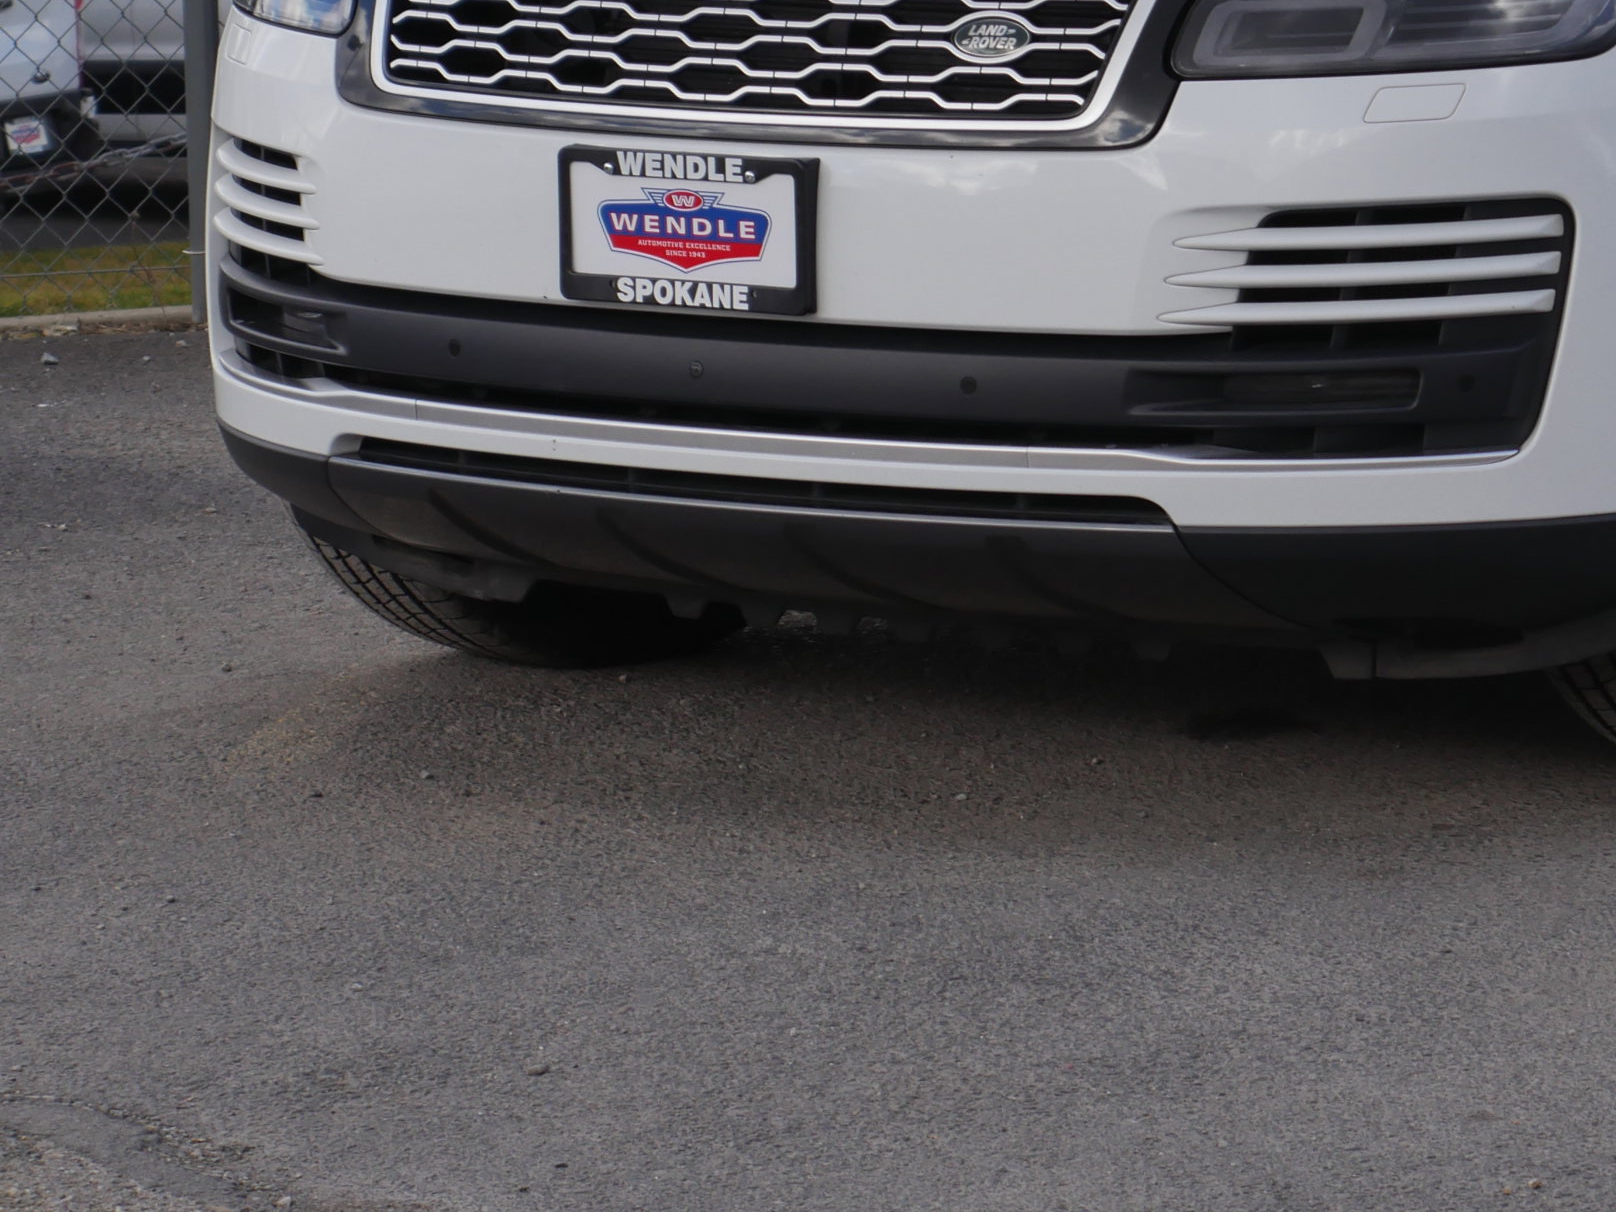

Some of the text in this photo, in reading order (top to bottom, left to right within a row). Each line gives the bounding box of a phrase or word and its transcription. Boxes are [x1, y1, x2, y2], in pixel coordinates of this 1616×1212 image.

[968, 24, 1008, 36] LAND
[968, 36, 1017, 50] ROVER
[616, 150, 744, 183] WENDLE
[610, 212, 756, 239] WENDLE
[637, 239, 731, 252] AUTOMOTIVE EXCELLENCE
[665, 249, 687, 257] SINCE
[617, 277, 749, 311] SPOKANE
